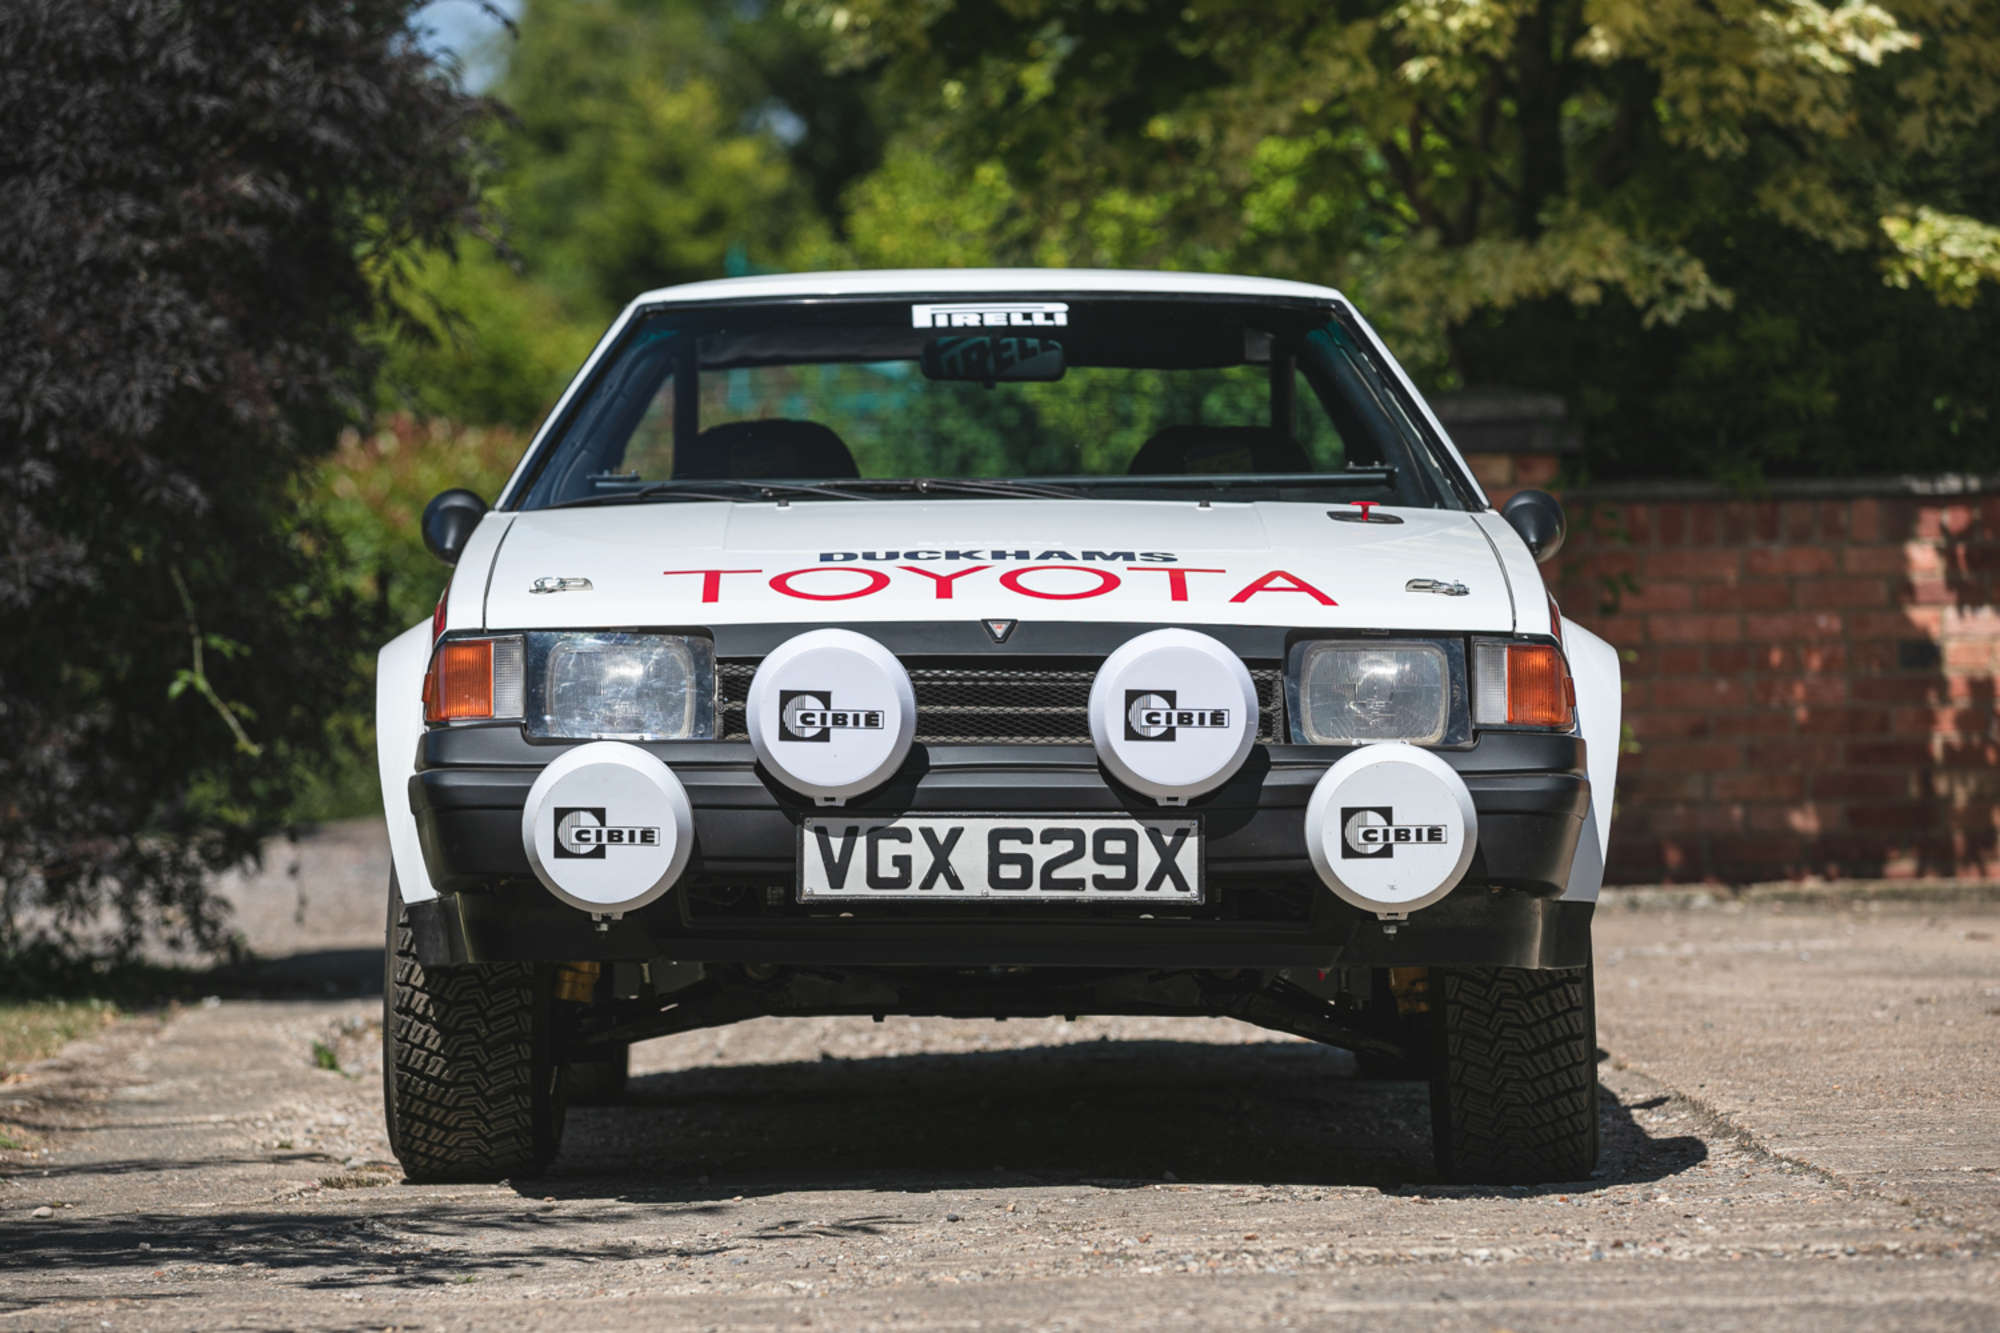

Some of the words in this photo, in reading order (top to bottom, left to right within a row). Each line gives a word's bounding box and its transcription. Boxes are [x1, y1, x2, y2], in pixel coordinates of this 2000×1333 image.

[911, 302, 1069, 328] PIRELLI
[819, 549, 1179, 563] DUCKHAMS
[663, 565, 1339, 606] TOYOTA
[813, 826, 965, 891] VGX
[987, 827, 1192, 892] 629X
